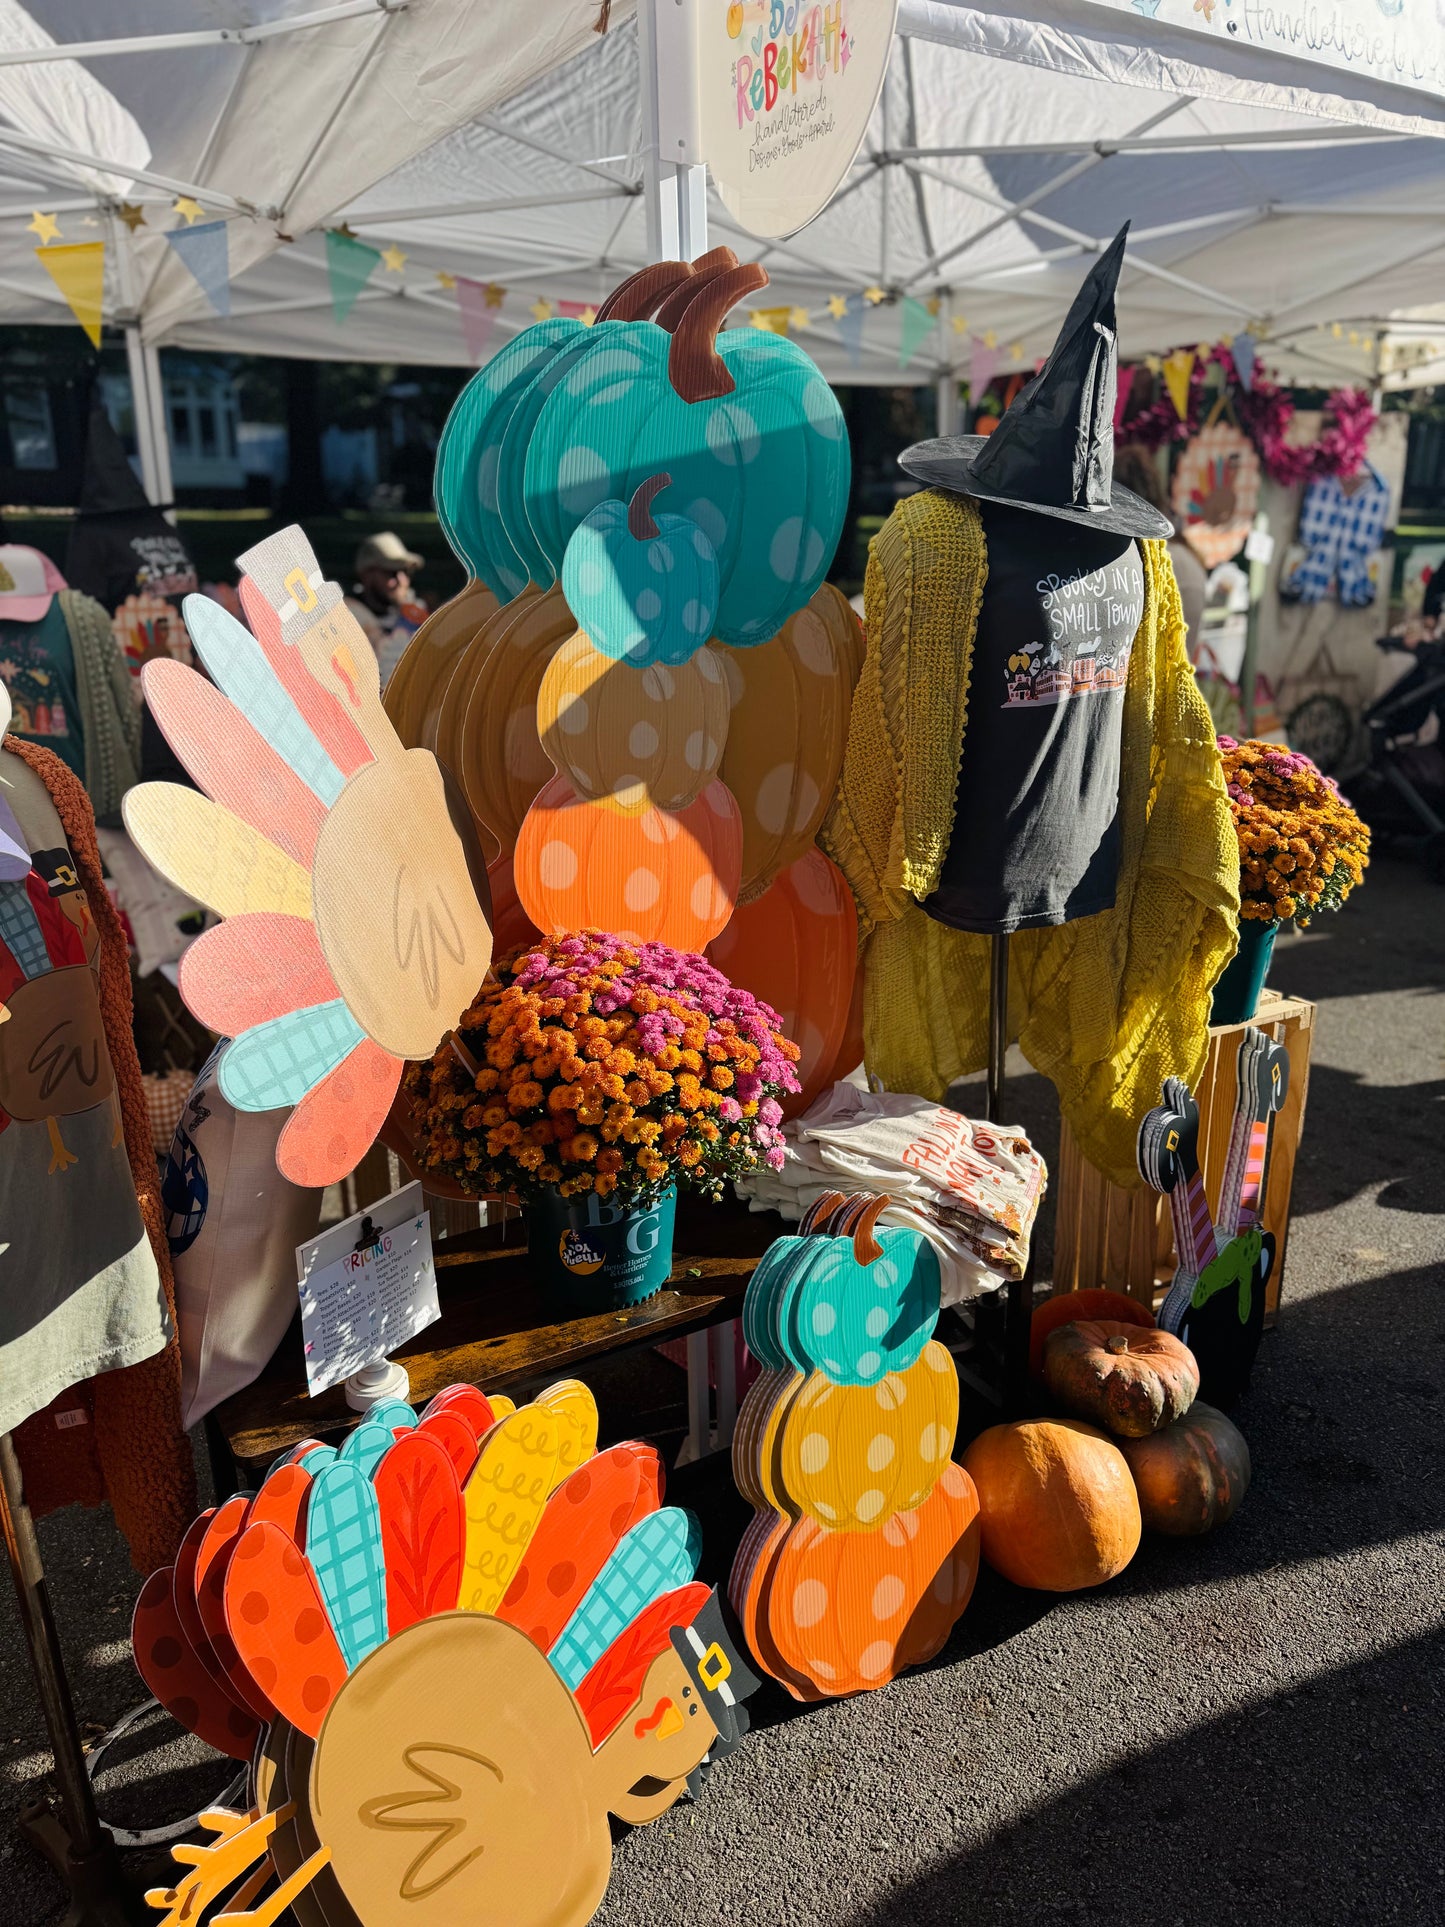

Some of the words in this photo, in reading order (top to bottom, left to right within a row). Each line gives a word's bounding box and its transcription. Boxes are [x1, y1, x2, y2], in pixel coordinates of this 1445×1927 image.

[1131, 567, 1143, 594] A
[1050, 602, 1101, 639] SMALL
[903, 1130, 956, 1178] FALL
[626, 1212, 662, 1255] G
[627, 1253, 652, 1267] Homes
